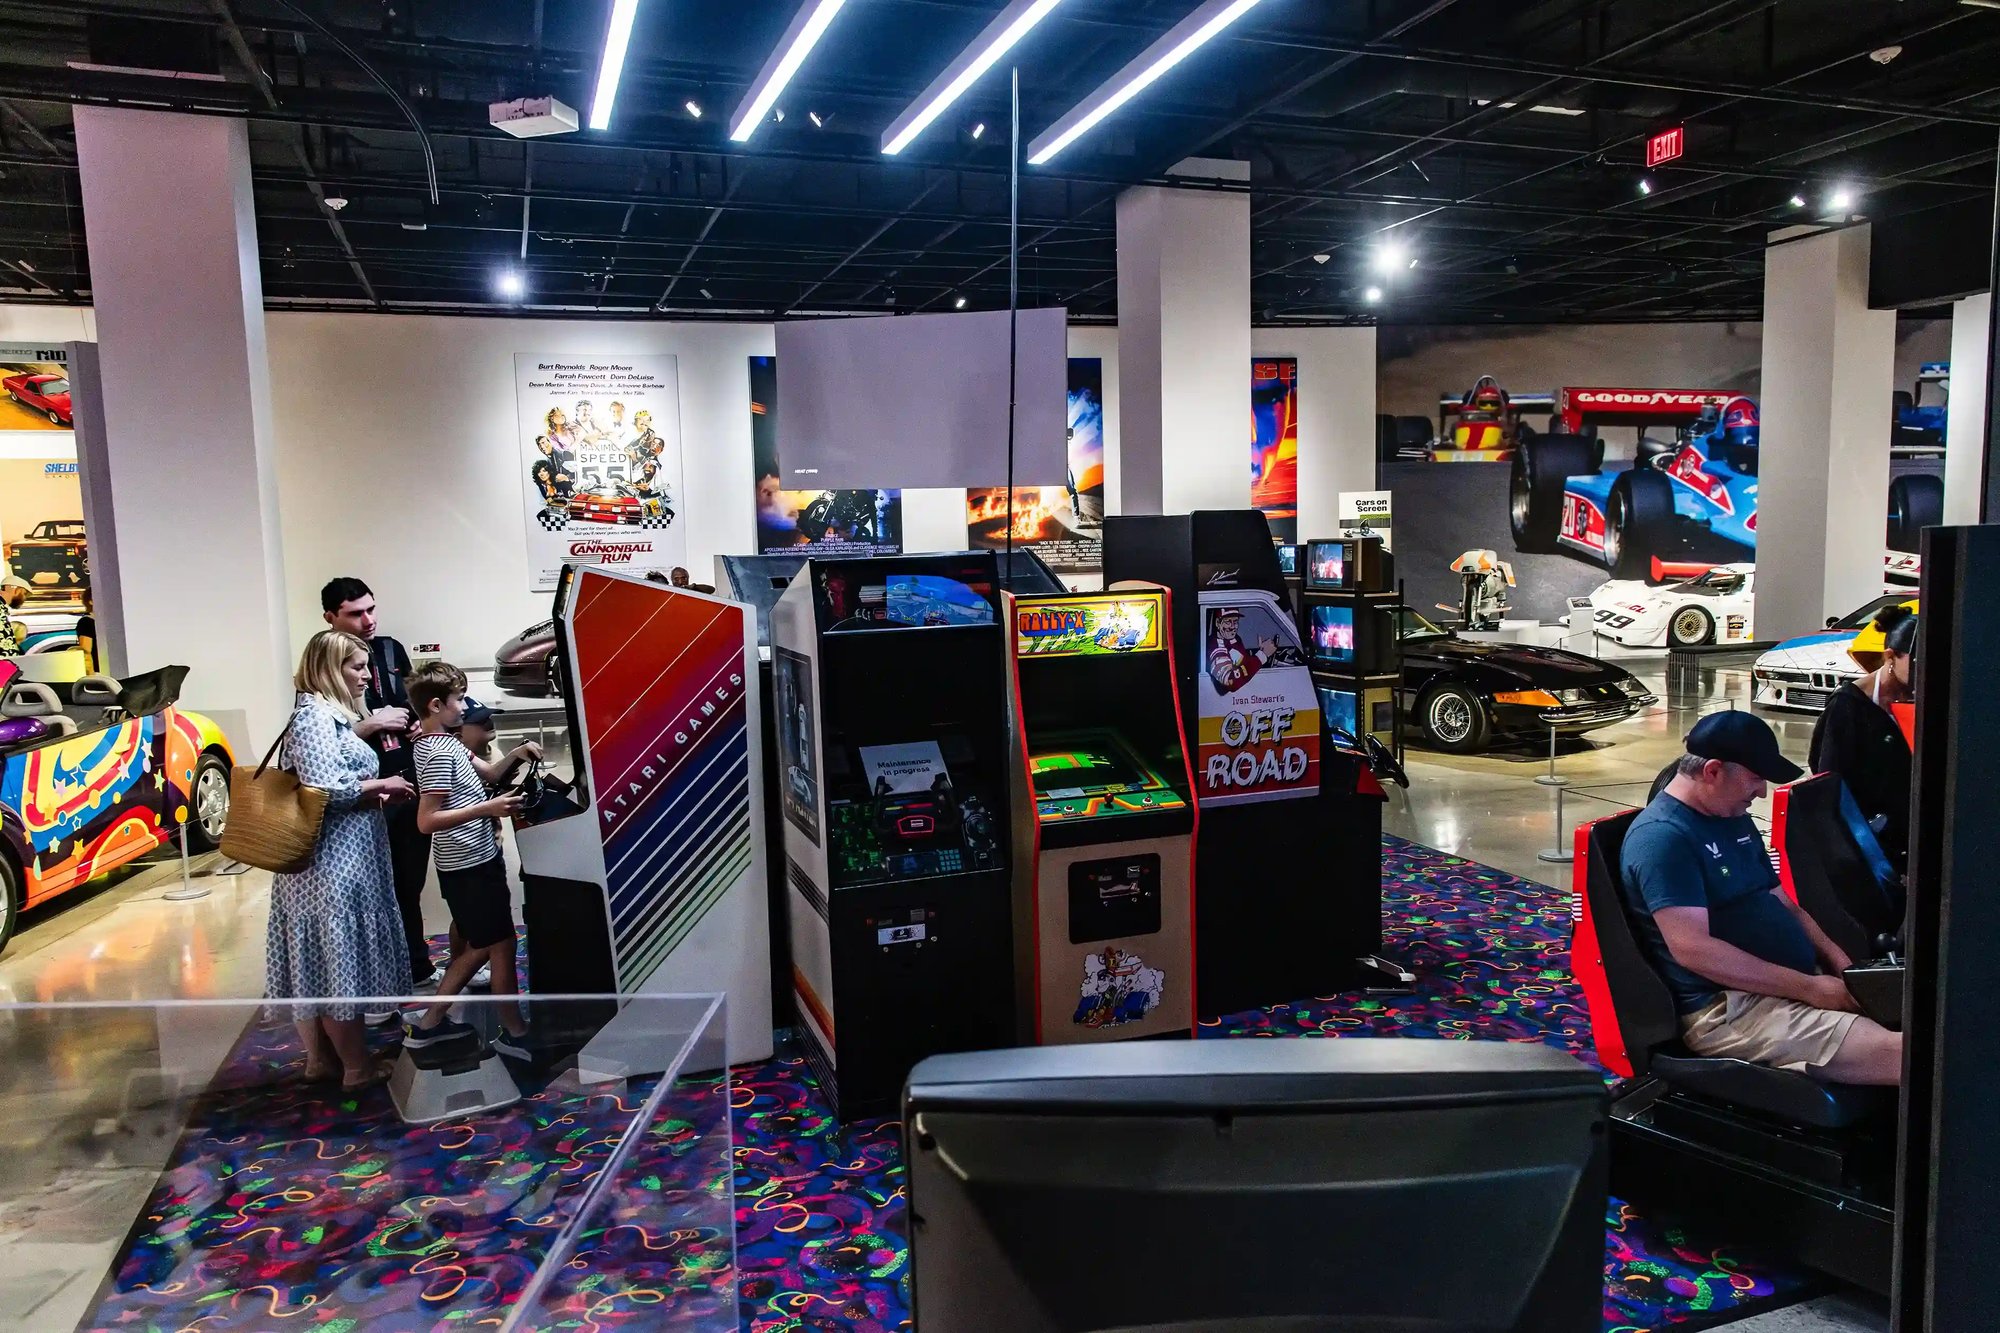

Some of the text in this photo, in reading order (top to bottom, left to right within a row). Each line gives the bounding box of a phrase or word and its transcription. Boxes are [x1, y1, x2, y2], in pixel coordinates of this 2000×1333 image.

[1654, 131, 1677, 162] EXIT
[1577, 393, 1729, 404] GOODYEAR
[580, 453, 627, 463] SPEED
[582, 466, 625, 484] 55
[570, 543, 653, 556] CANNONBALL
[600, 553, 632, 564] RUN
[1614, 601, 1647, 614] EAGL
[1594, 610, 1635, 629] 99
[1232, 695, 1285, 705] Ivan Stewart's
[1221, 707, 1295, 747] OFF
[603, 673, 742, 822] ATARI GAMES
[877, 759, 931, 768] Maintenance
[1206, 747, 1309, 789] ROAD
[893, 766, 930, 776] progress
